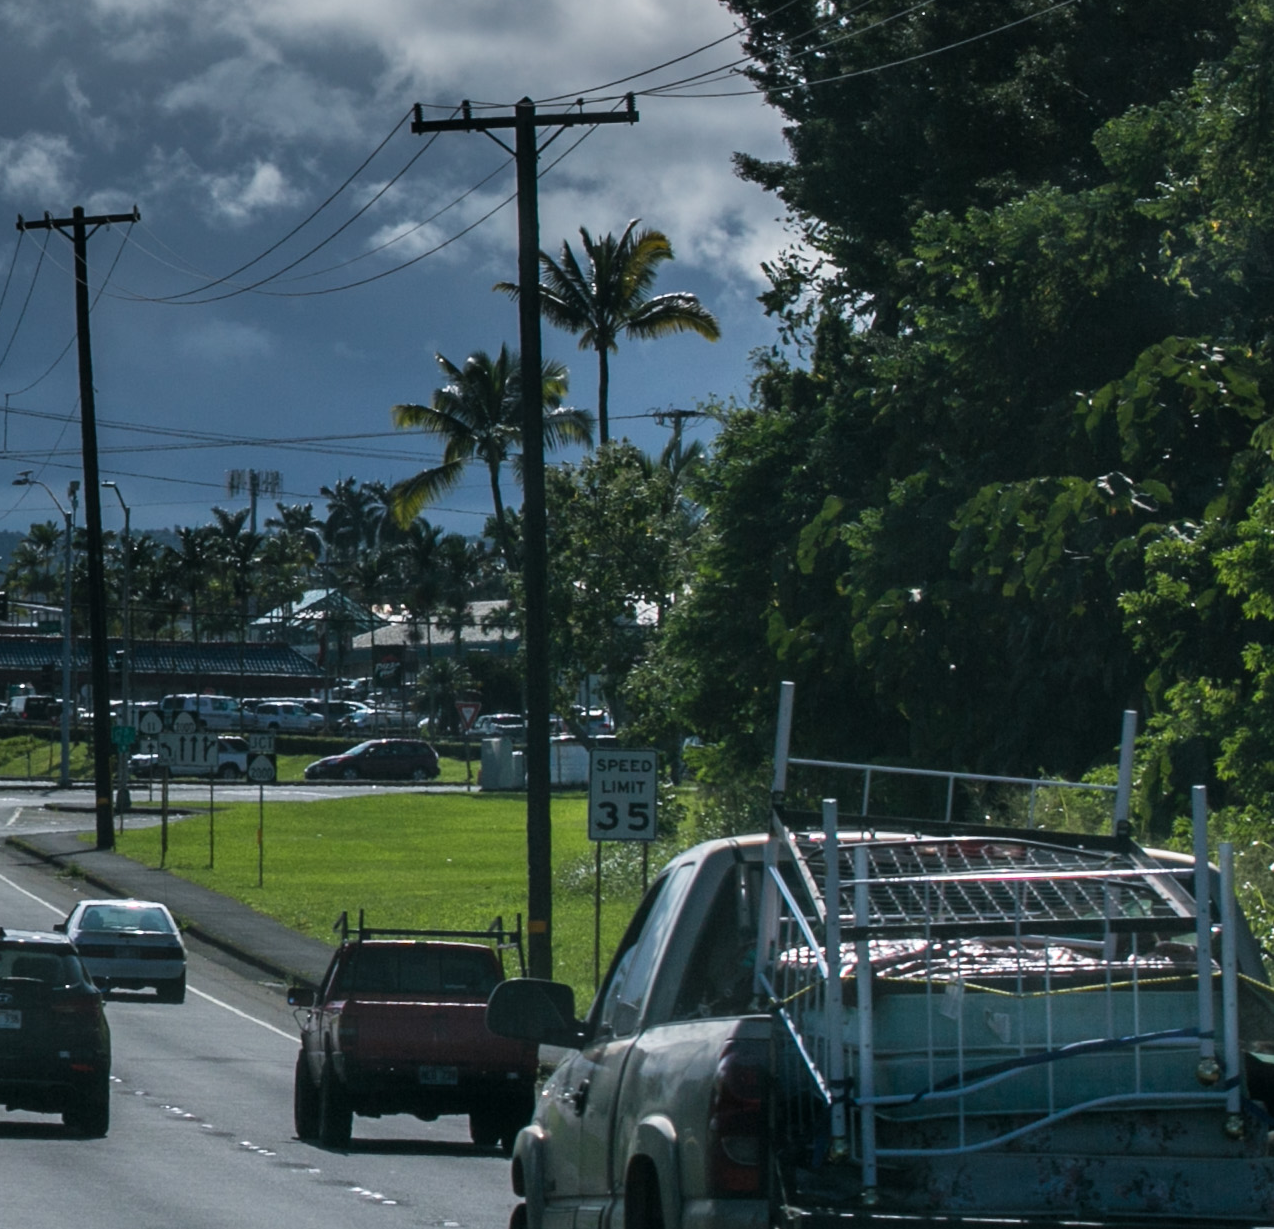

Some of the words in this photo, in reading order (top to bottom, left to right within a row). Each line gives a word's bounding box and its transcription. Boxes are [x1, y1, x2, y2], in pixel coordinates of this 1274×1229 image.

[251, 736, 273, 749] JCT
[596, 758, 652, 773] SPEED
[602, 780, 645, 794] LIMIT
[596, 801, 649, 832] 35
